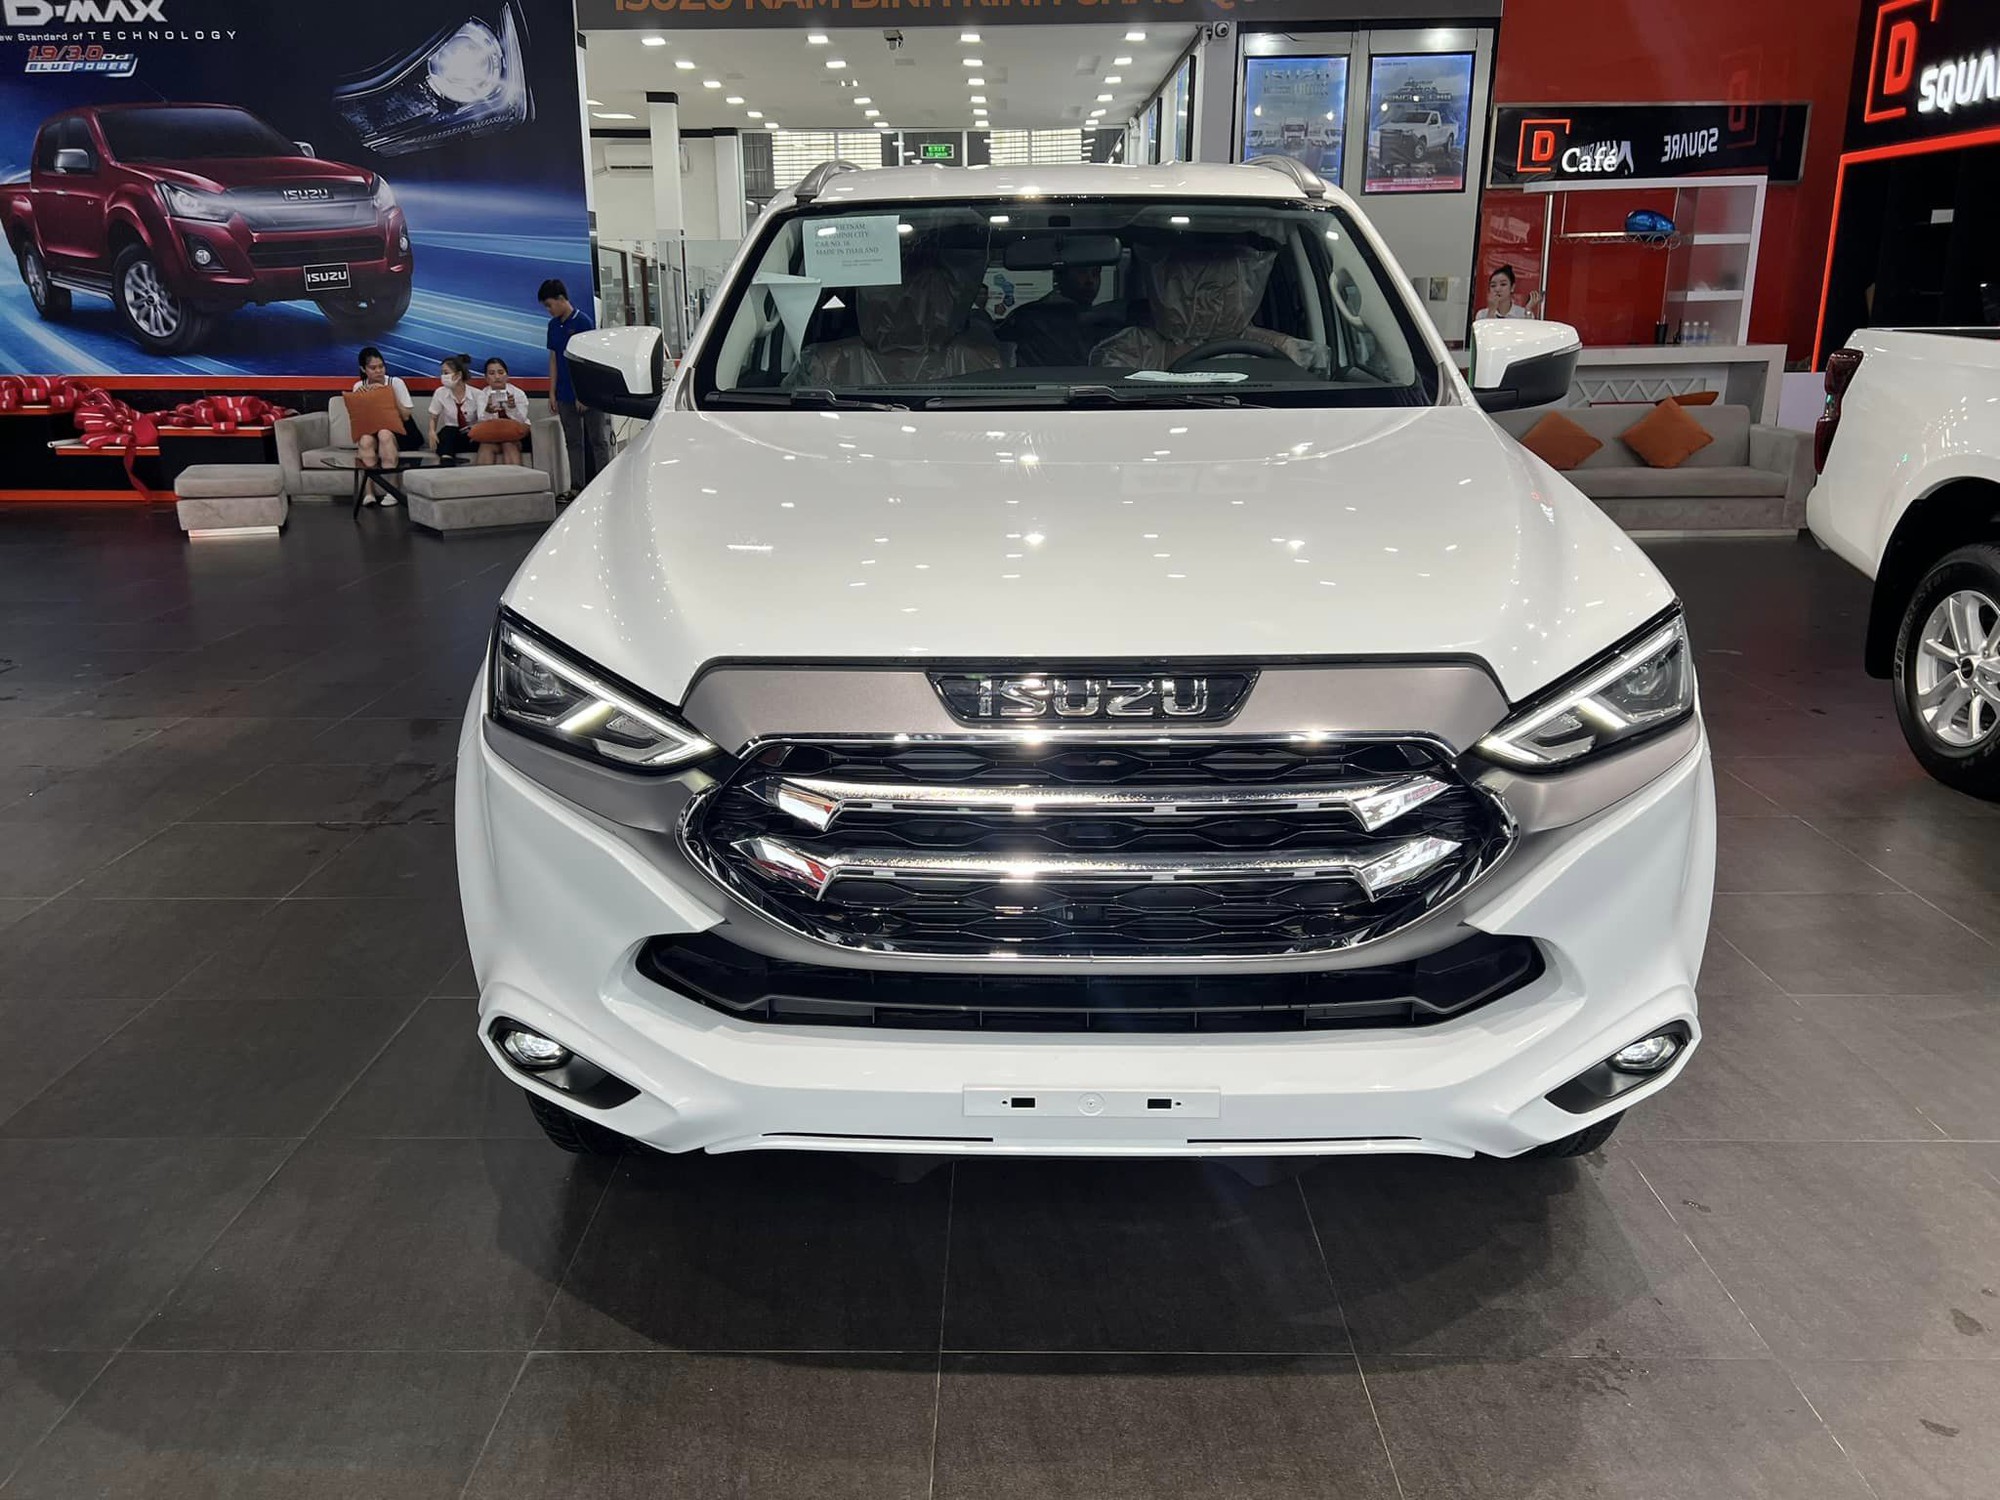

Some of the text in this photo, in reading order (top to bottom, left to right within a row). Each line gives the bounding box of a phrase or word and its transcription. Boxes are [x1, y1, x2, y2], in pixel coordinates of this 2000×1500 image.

[17, 33, 68, 41] Standard
[88, 31, 237, 40] TECHNOLOGY
[1562, 147, 1618, 173] Café
[284, 189, 329, 200] ISUZU
[845, 246, 878, 254] THAILAND
[307, 271, 347, 282] ISUZU
[978, 678, 1207, 716] ISUZU
